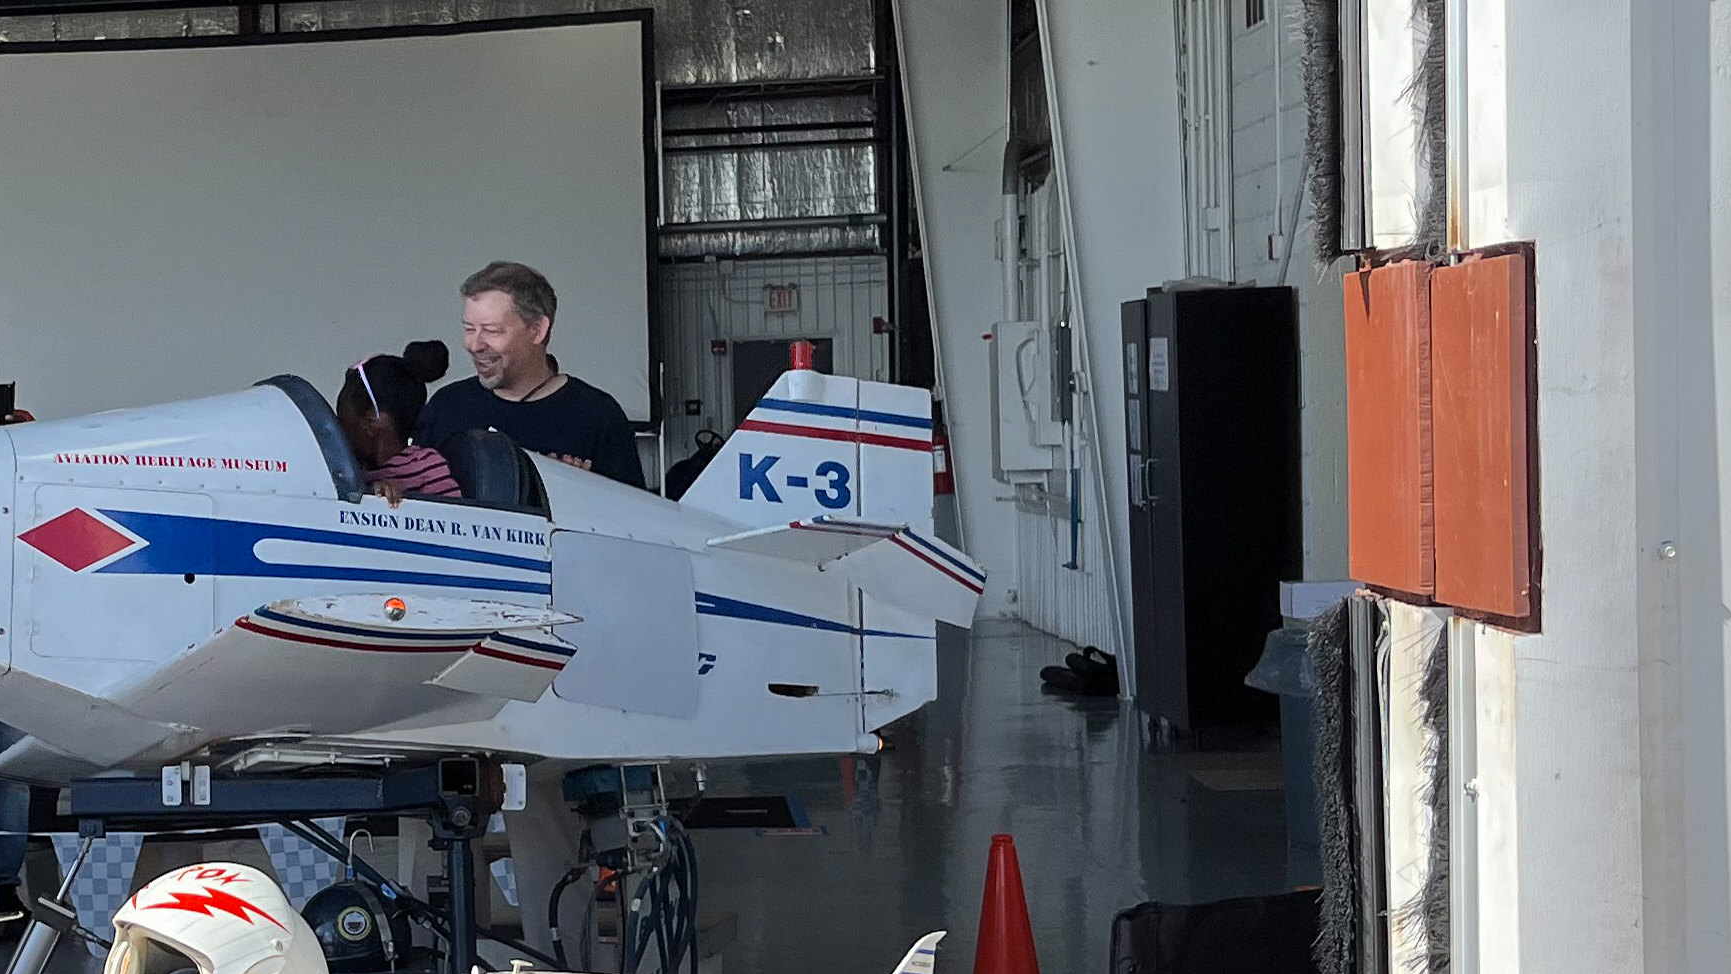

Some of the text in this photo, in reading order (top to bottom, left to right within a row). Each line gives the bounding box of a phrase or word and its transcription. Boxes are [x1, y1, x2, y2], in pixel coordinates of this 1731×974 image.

[769, 289, 794, 309] EXIT
[53, 453, 288, 473] AVIATION HERITAGE MUSEUM
[739, 452, 851, 510] K-3
[339, 510, 546, 546] ENSIGN DEAN R. VAN KIRK
